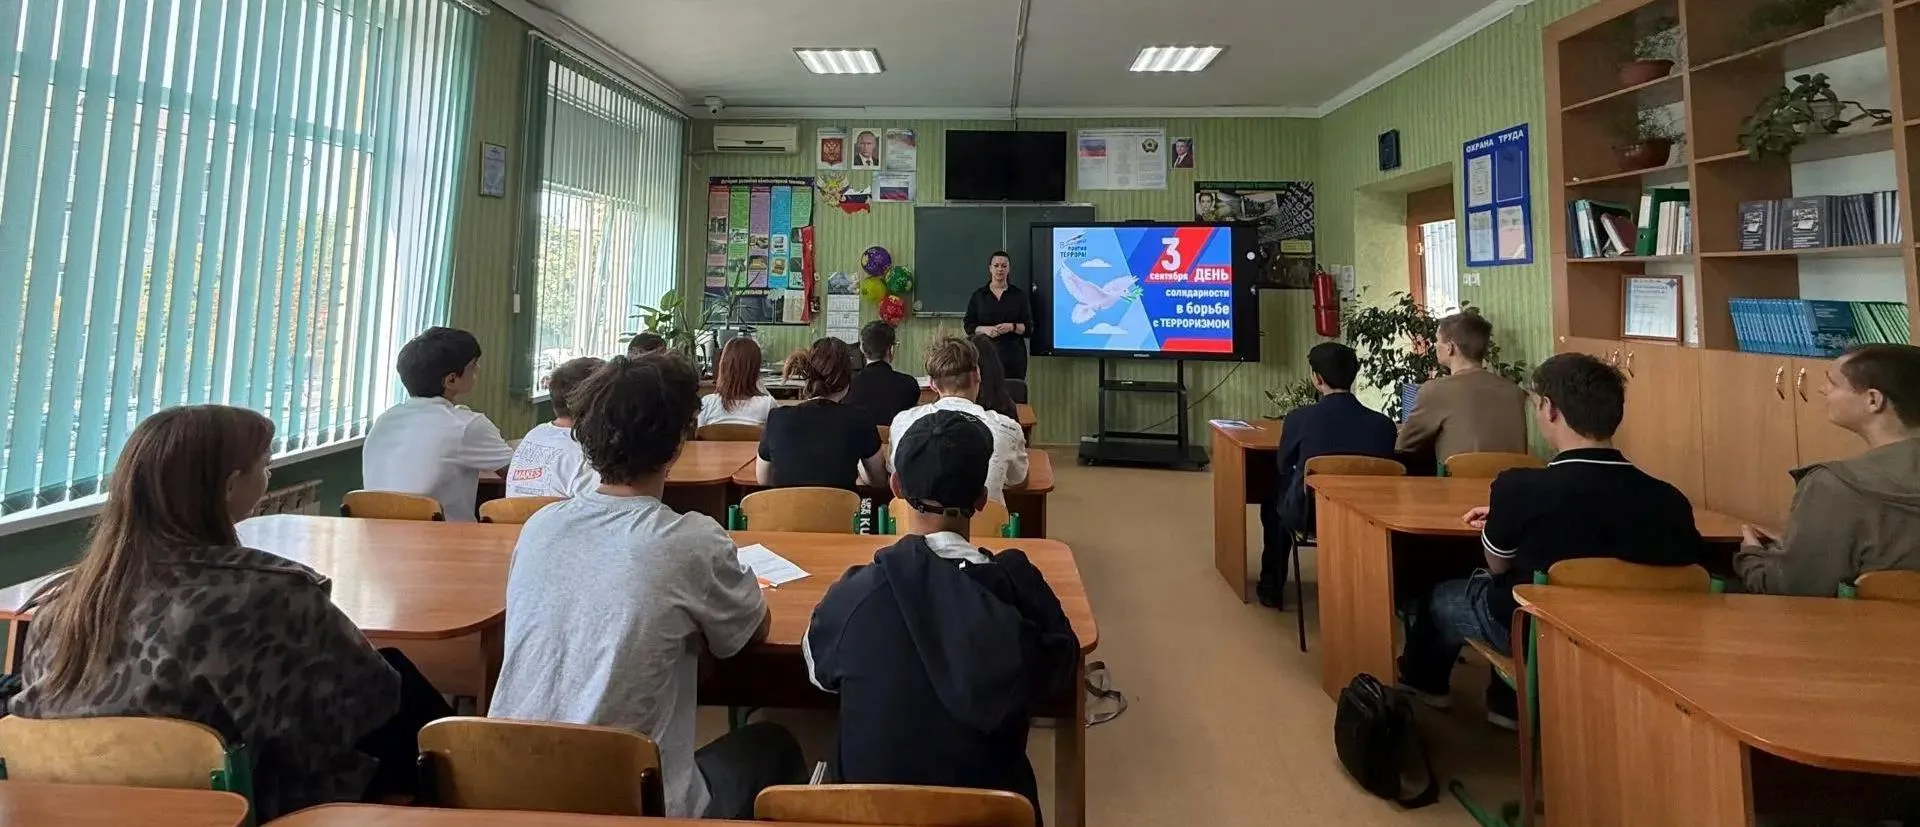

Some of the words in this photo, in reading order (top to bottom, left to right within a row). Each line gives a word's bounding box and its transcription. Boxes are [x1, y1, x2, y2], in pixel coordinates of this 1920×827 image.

[1465, 139, 1494, 153] ОХРАНА
[1498, 129, 1524, 144] ТРУДА
[1161, 237, 1181, 271] 3
[1149, 271, 1188, 281] сентября
[1194, 267, 1229, 282] ДЕНЬ
[1165, 288, 1230, 298] солидарности
[1176, 304, 1184, 314] в
[1186, 301, 1230, 317] борьбе
[1152, 319, 1159, 328] с
[1160, 318, 1230, 328] ТЕРРОРИЗМОМ
